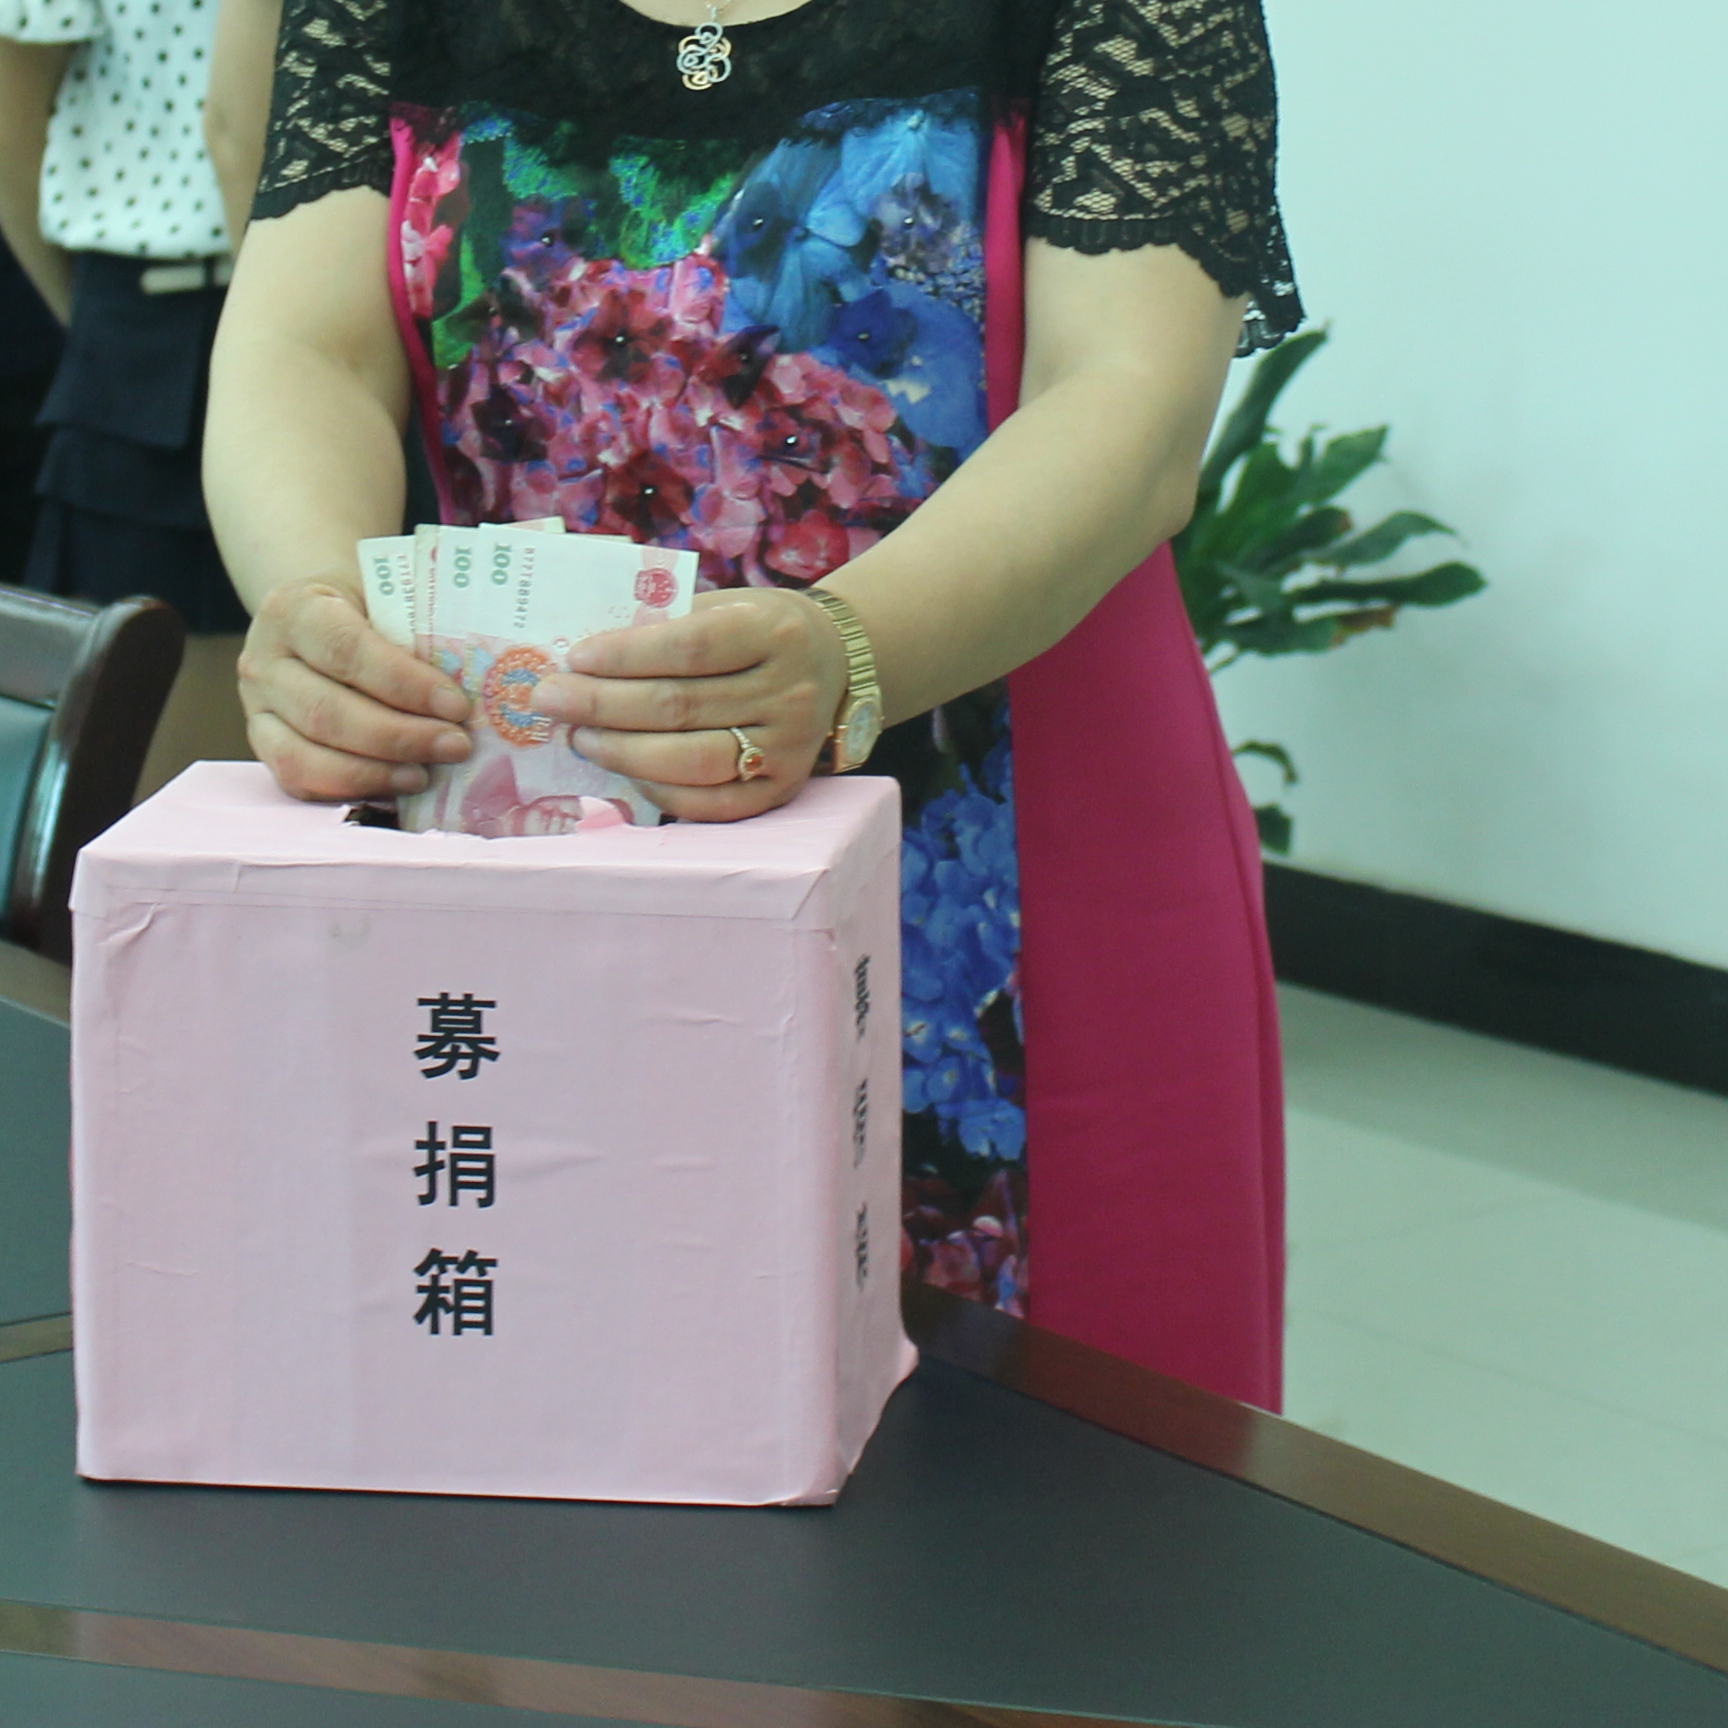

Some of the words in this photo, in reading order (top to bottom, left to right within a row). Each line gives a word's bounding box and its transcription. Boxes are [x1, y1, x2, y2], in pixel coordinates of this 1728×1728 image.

[373, 557, 396, 597] 100
[452, 546, 473, 589] 100
[490, 543, 513, 587] 100
[413, 991, 501, 1337] 募捐箱
